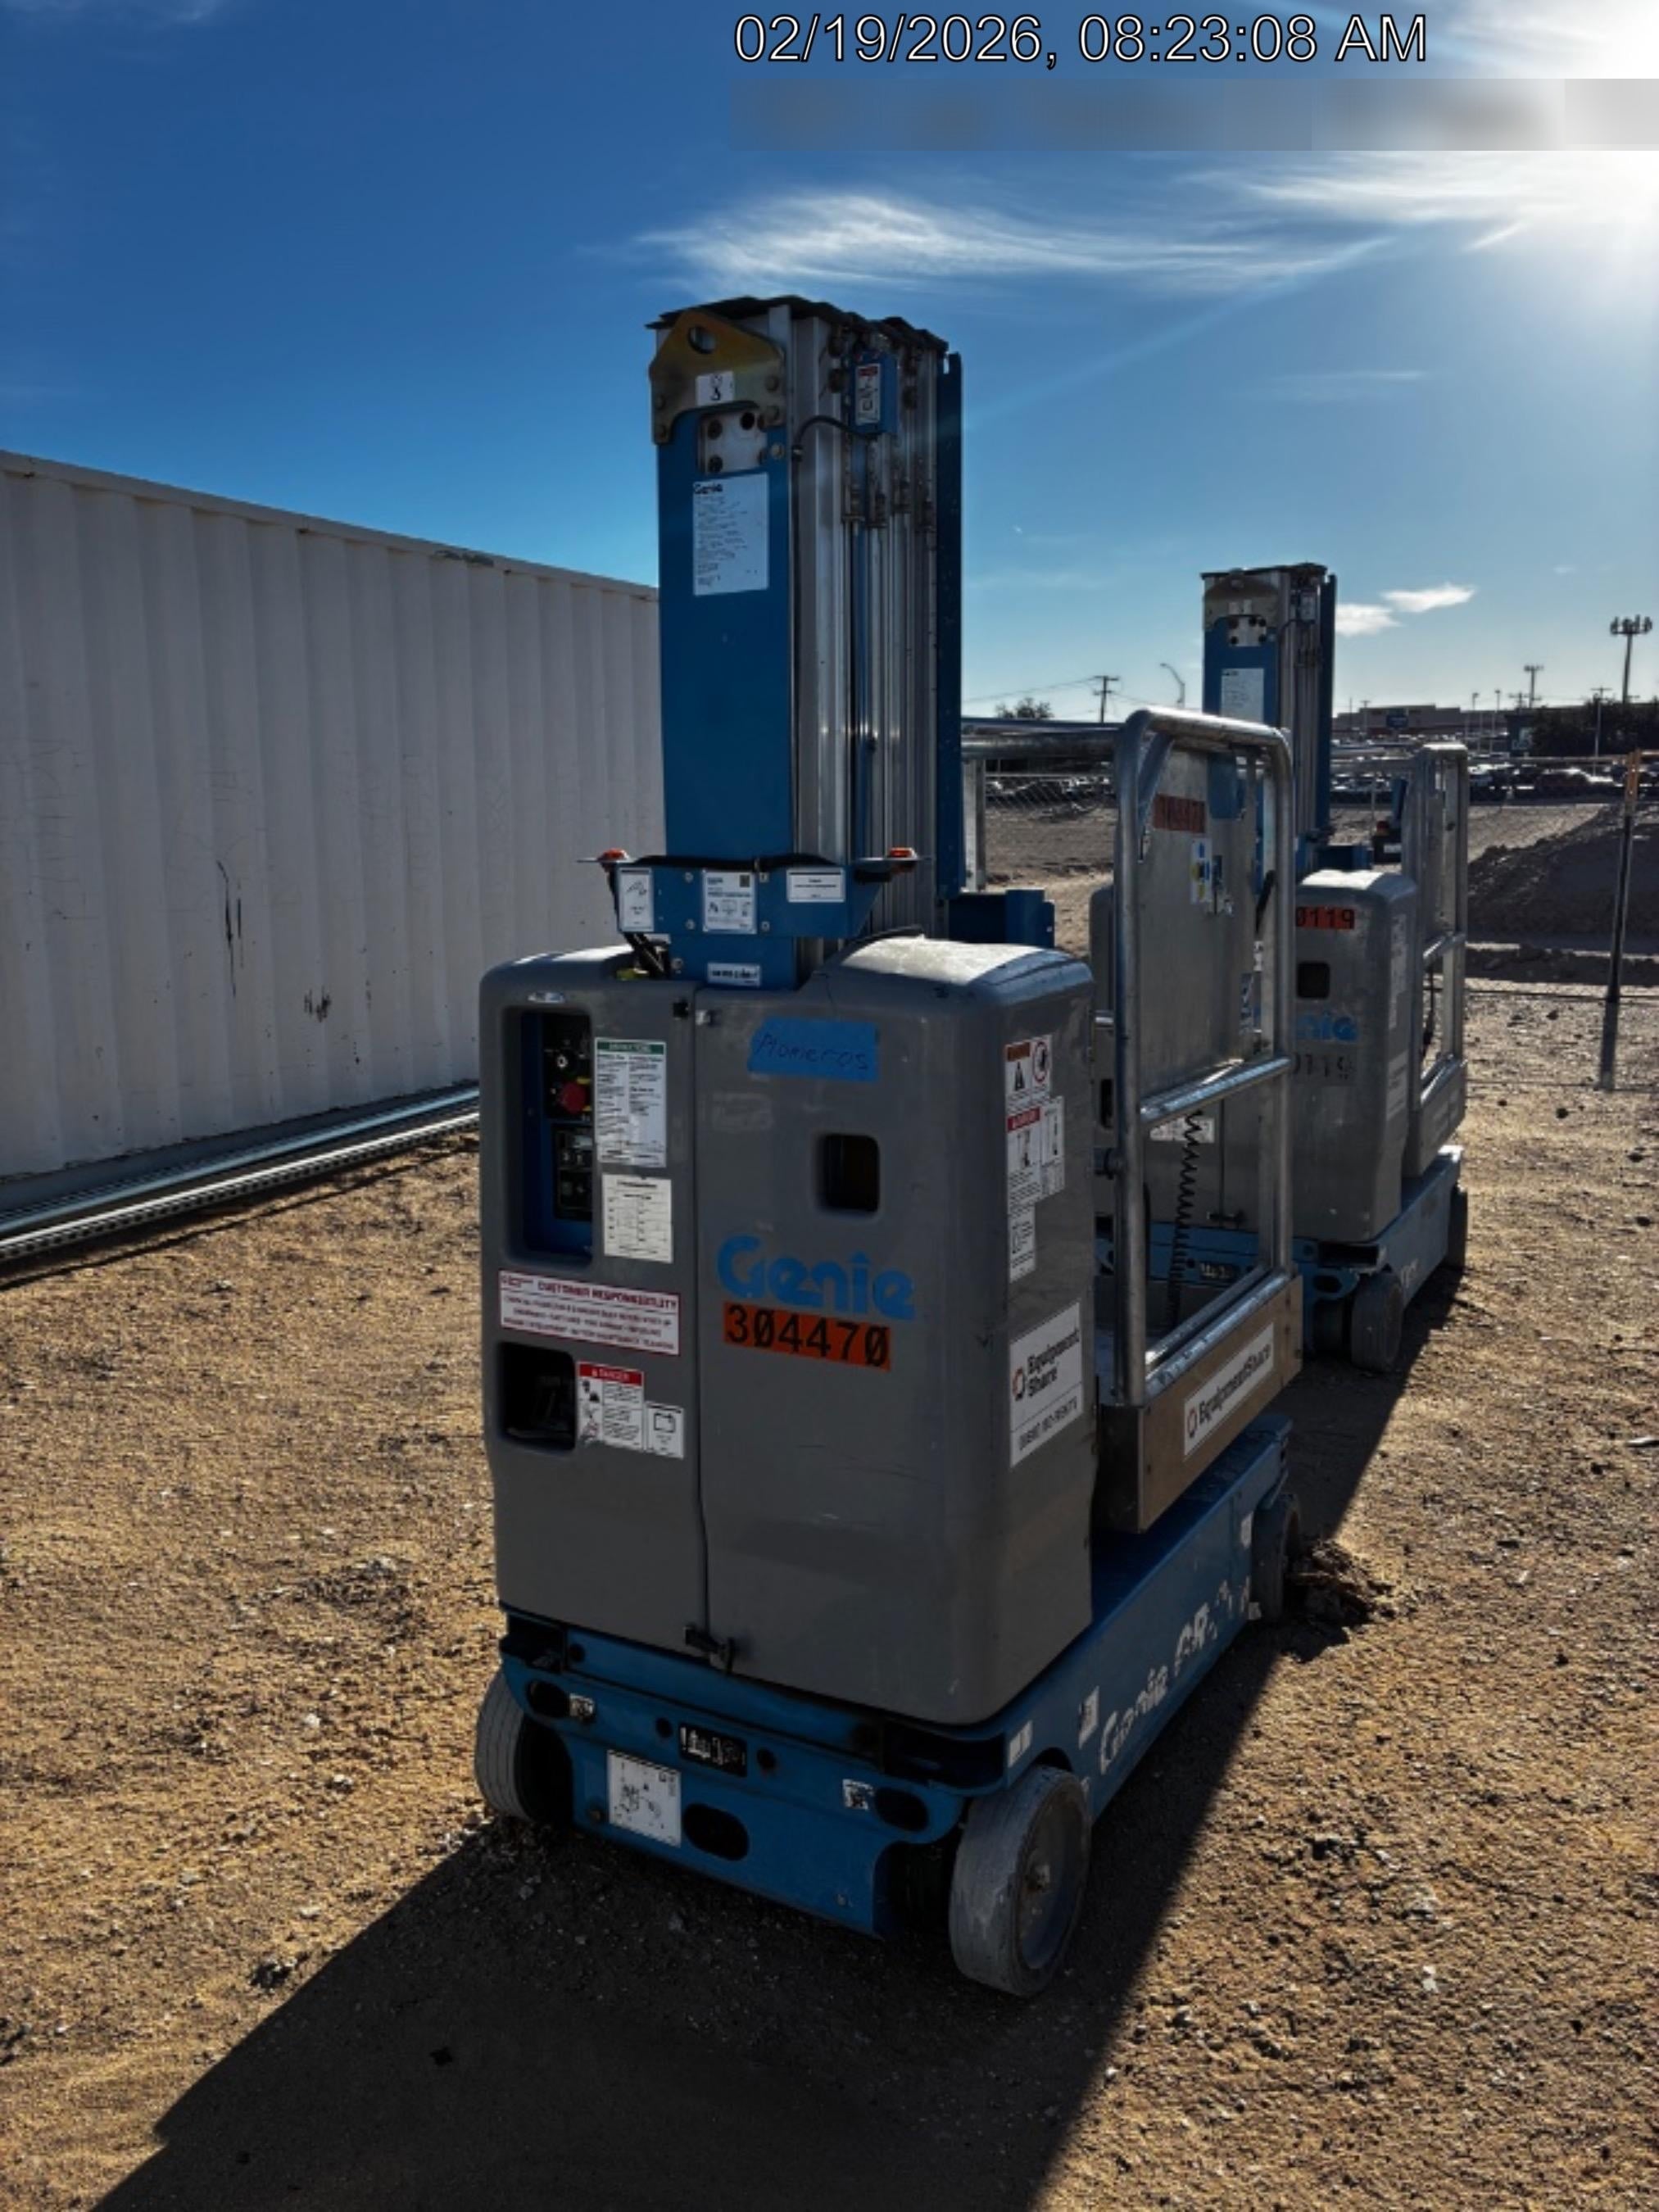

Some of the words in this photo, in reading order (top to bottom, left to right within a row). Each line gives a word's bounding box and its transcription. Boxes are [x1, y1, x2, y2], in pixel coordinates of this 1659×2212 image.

[1296, 906, 1355, 928] 0119
[537, 1281, 590, 1298] CUSTOMER
[592, 1287, 678, 1311] RESPONSIBILITY
[716, 1233, 916, 1321] Genie
[726, 1303, 891, 1368] 304470
[1027, 1327, 1080, 1375] Equipment
[1027, 1367, 1058, 1398] Share
[1199, 1343, 1271, 1425] EquipmentShare
[1099, 1665, 1169, 1776] Genie
